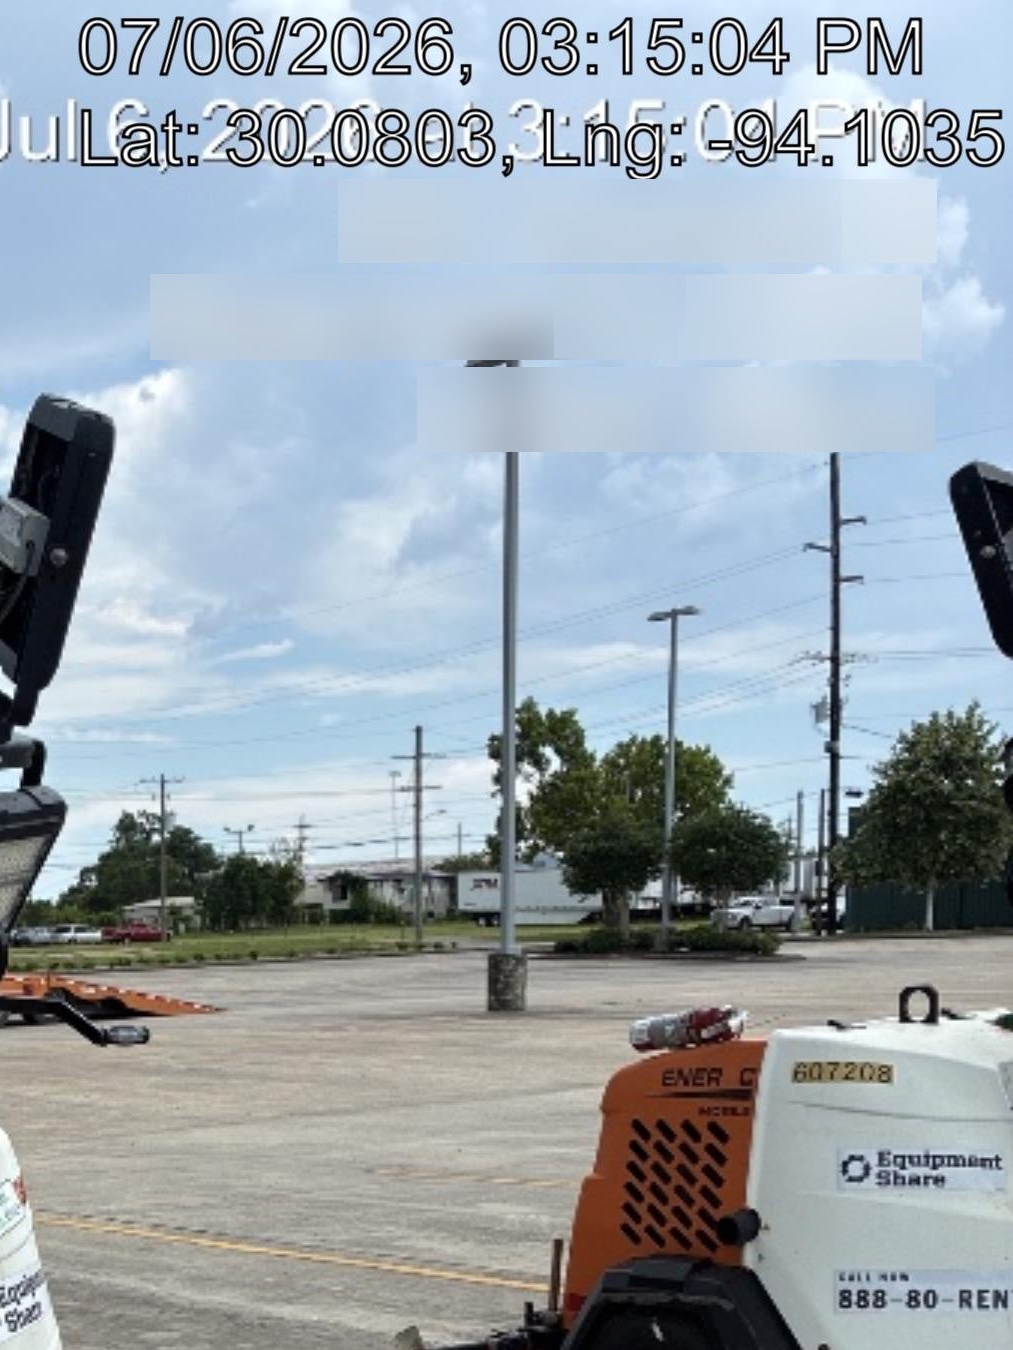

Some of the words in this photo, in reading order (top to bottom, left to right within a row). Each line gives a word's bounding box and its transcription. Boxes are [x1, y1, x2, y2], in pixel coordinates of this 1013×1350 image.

[791, 1062, 894, 1084] 607208
[876, 1150, 1004, 1171] Equipment
[875, 1169, 946, 1188] Share
[838, 1289, 1013, 1309] 888-80-REN
